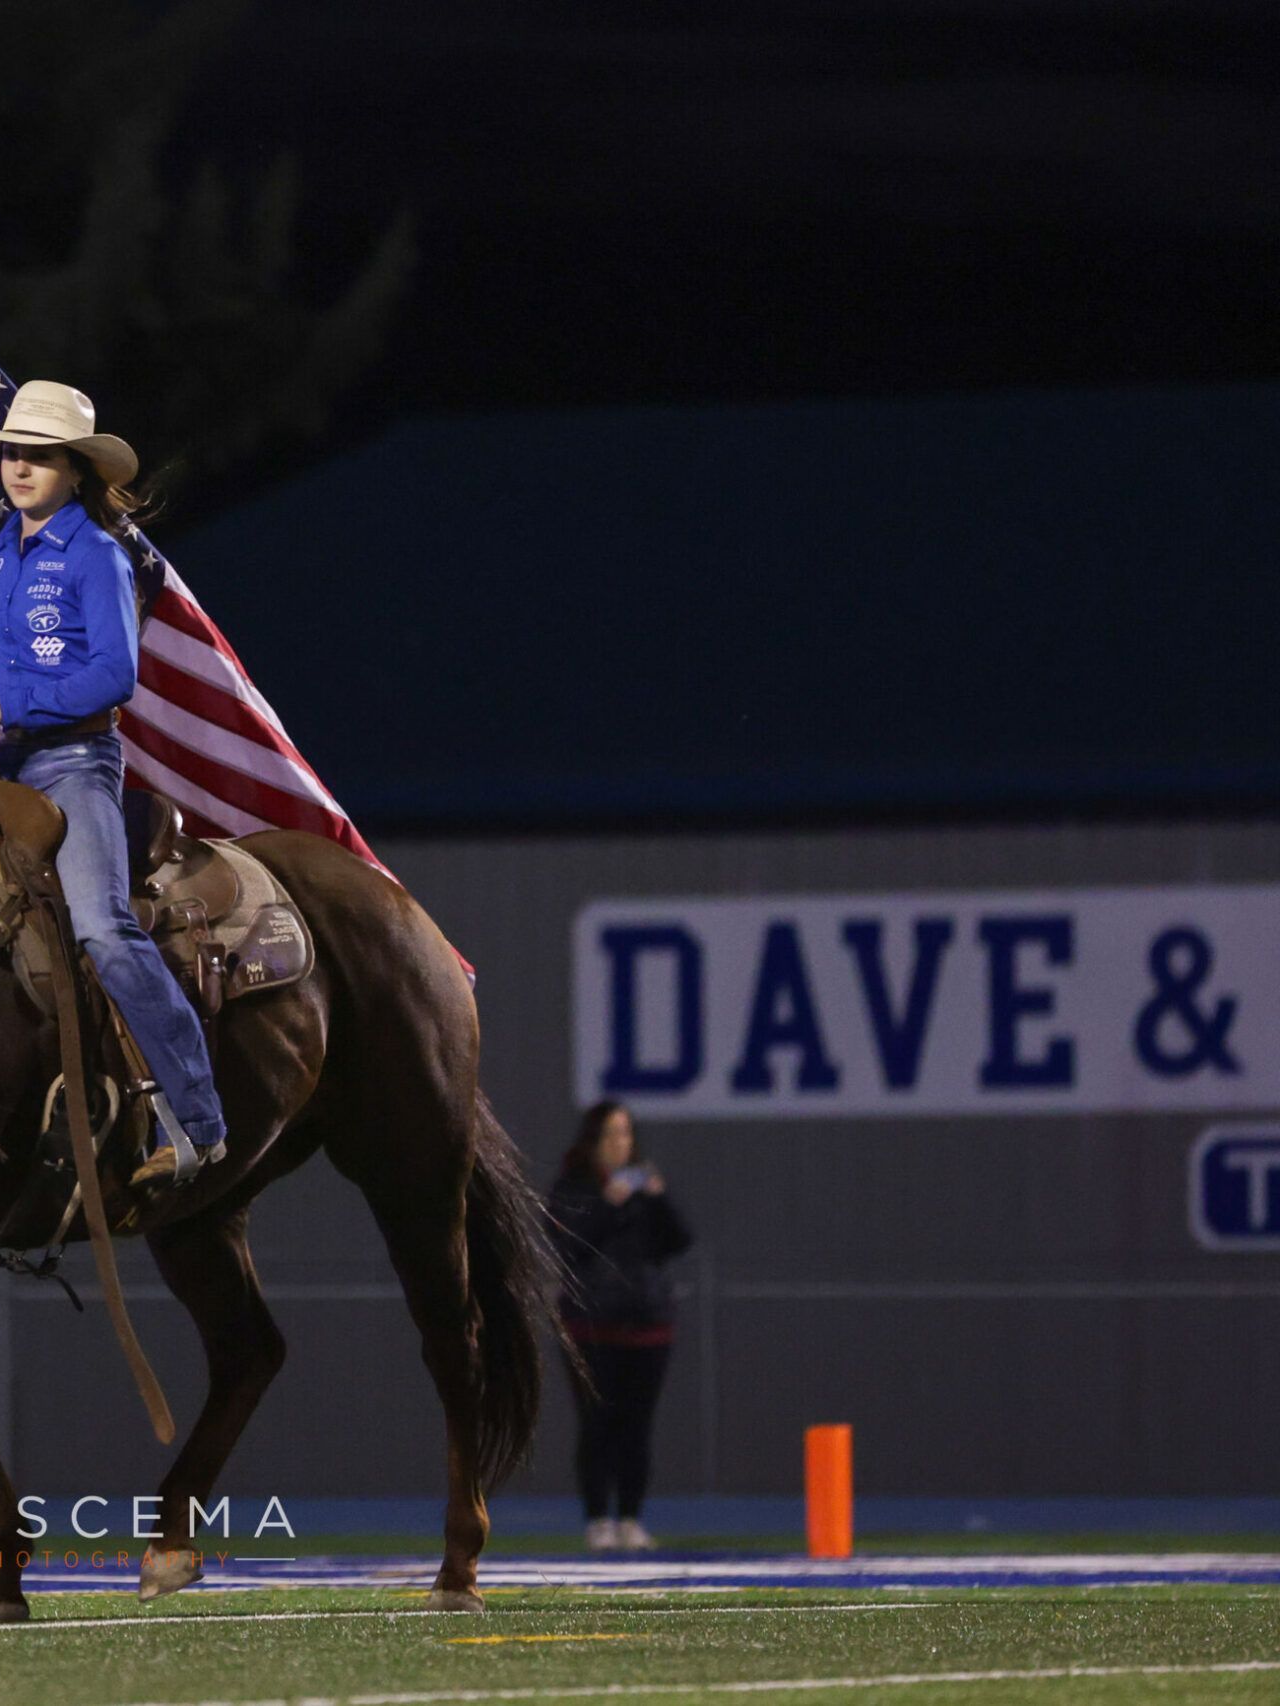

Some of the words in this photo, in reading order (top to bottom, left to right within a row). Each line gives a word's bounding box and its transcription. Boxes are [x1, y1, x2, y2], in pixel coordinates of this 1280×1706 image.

[26, 583, 63, 596] SADDLE
[600, 916, 1076, 1094] DAVE
[1134, 925, 1244, 1078] &
